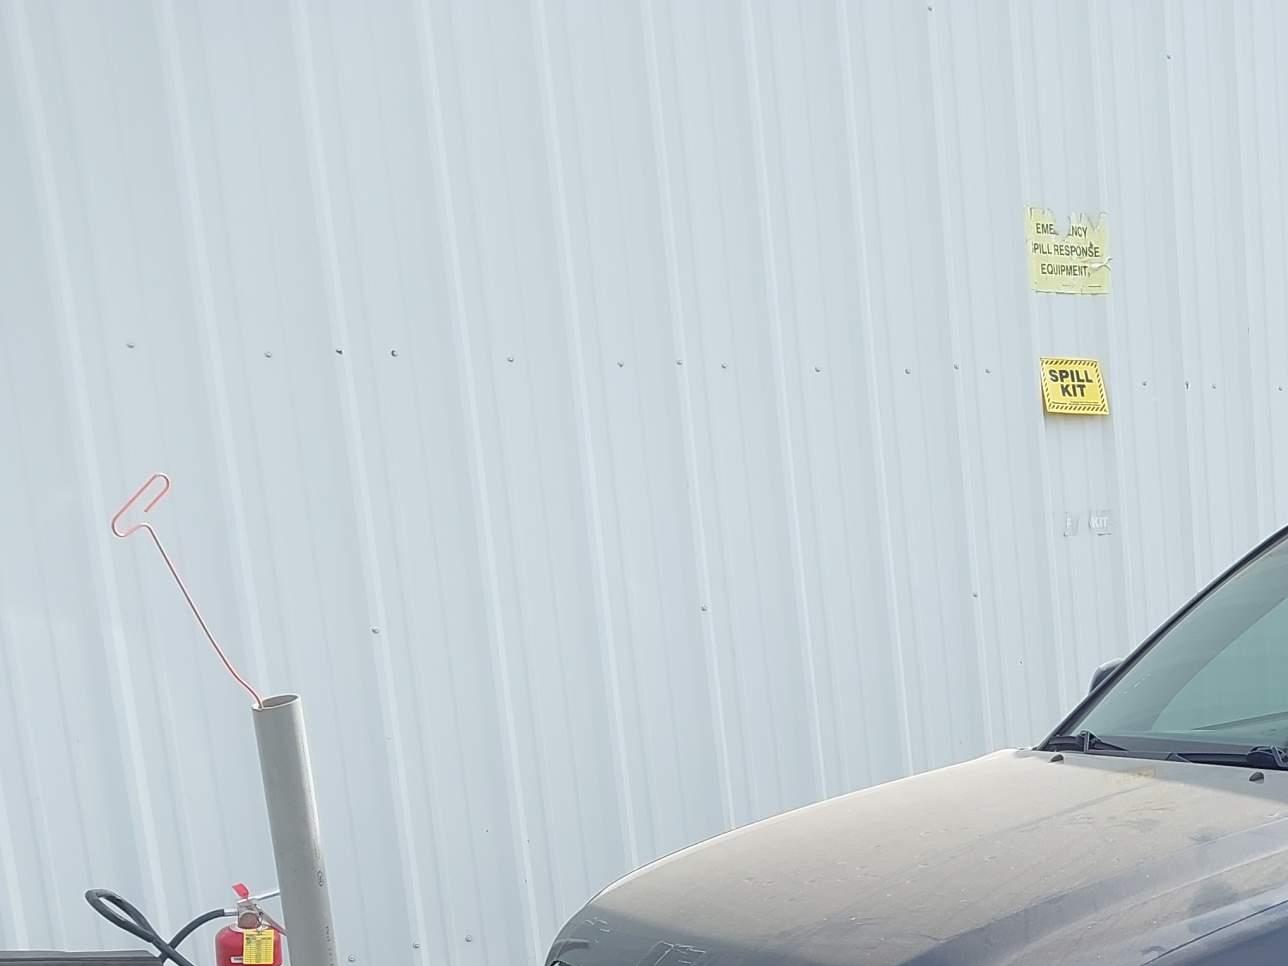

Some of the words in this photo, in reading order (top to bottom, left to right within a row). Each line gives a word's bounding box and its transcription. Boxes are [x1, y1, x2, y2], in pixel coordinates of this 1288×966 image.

[1035, 222, 1088, 239] EMENCY
[1032, 242, 1053, 255] PILL
[1054, 244, 1101, 258] RESPONSE
[1048, 369, 1093, 383] SPILL
[1060, 383, 1086, 397] KIT
